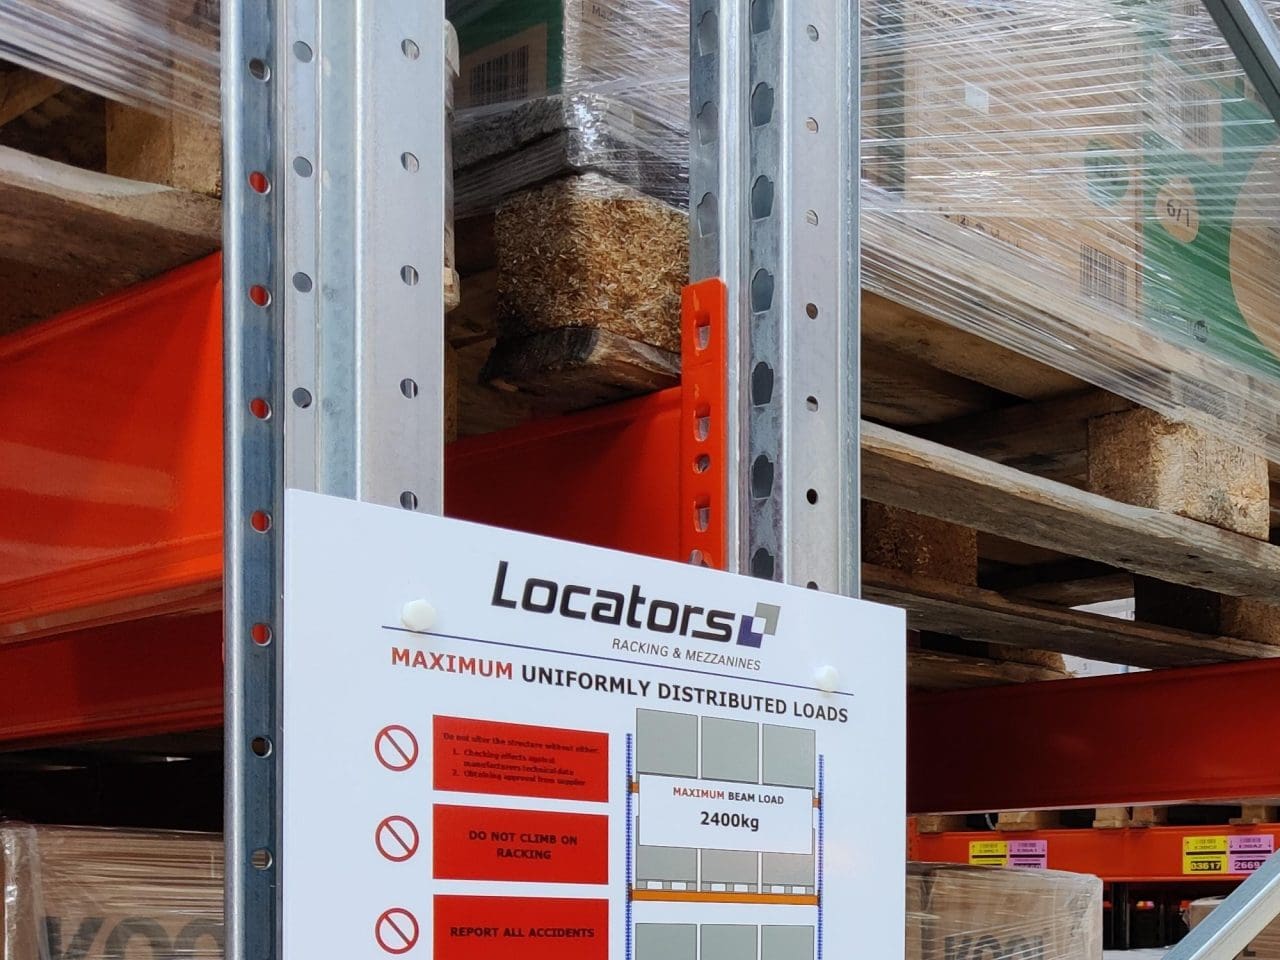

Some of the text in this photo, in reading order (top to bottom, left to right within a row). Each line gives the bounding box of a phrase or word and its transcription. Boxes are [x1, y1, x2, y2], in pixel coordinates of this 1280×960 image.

[491, 560, 736, 643] Locators
[612, 638, 761, 671] RACKING & MEZZANINES
[391, 647, 849, 723] MAXIMUM UNIFORMLY DISTRIBUTED LOADS
[673, 787, 784, 804] MAXIMUM BEAM LOAD
[700, 811, 759, 831] 2400kg
[469, 831, 577, 845] DO NOT CLIMB ON
[497, 848, 551, 859] RACKING
[1235, 861, 1263, 870] 2669
[450, 927, 594, 938] REPORT ALL ACCIDENTS
